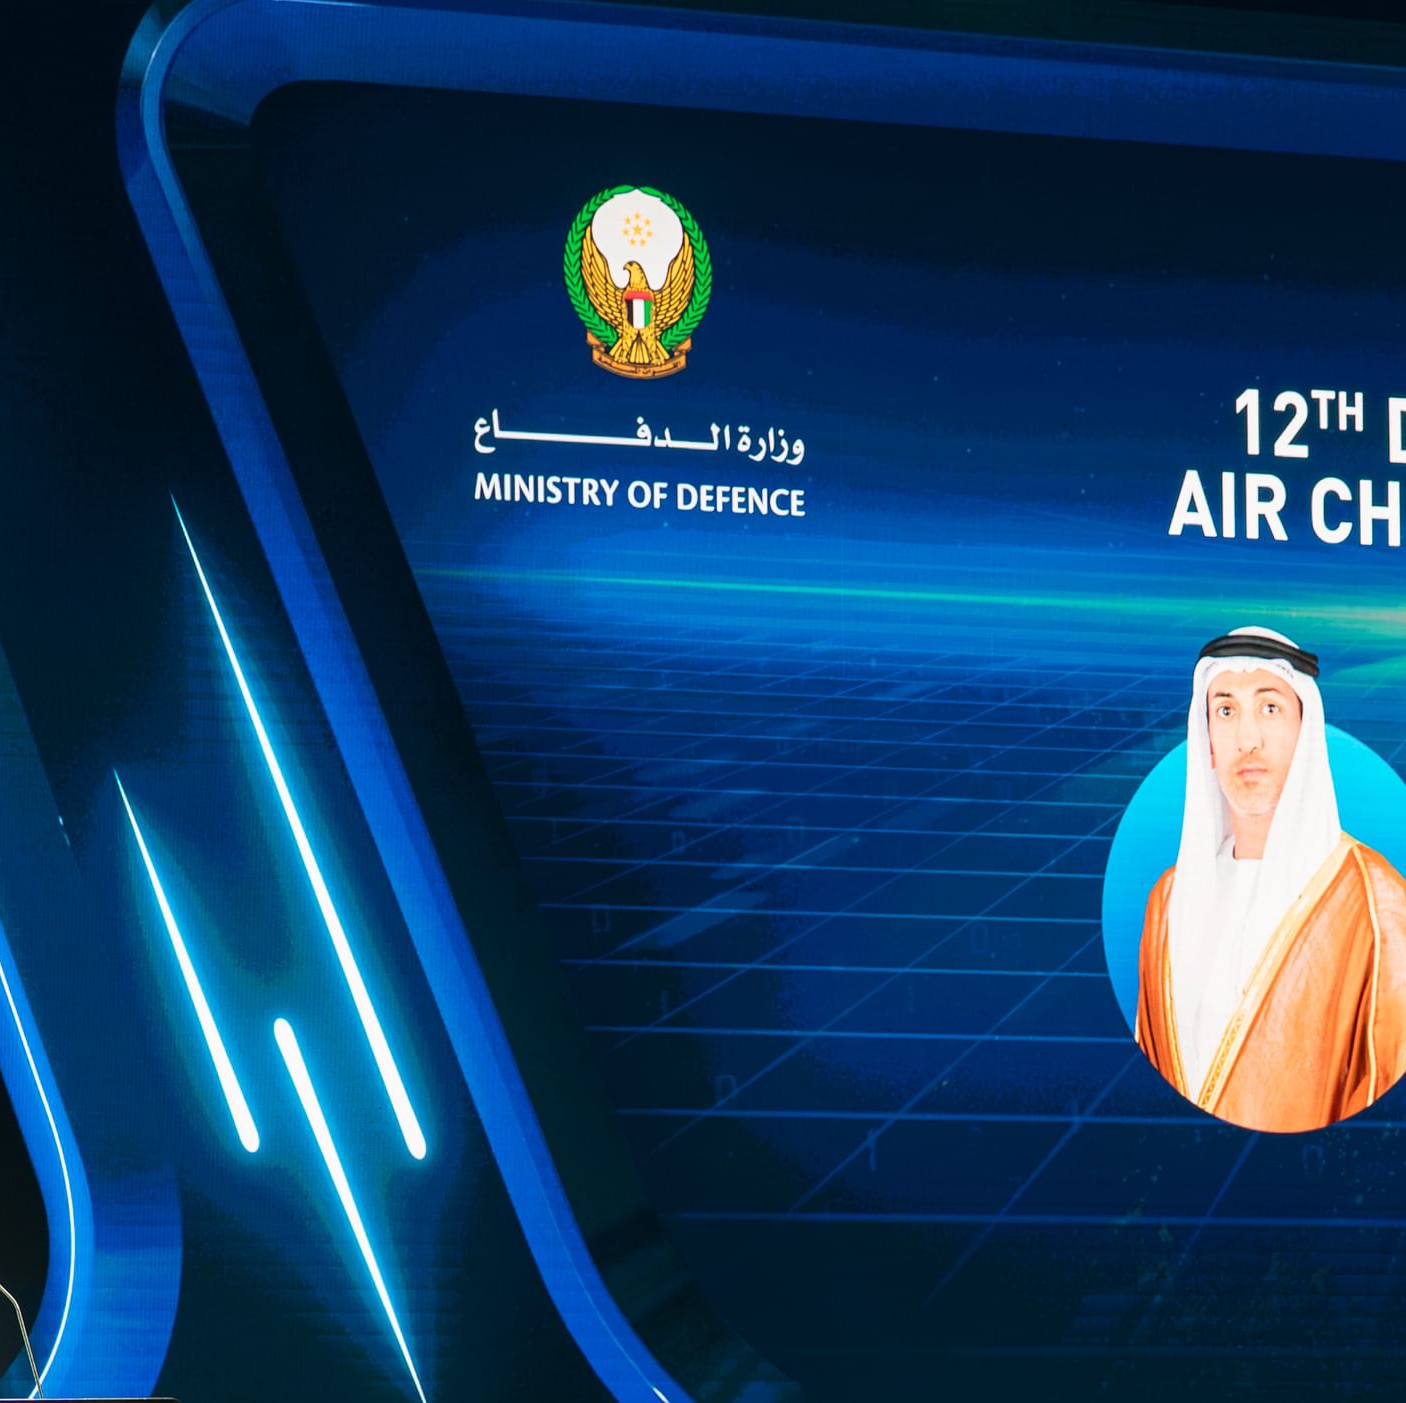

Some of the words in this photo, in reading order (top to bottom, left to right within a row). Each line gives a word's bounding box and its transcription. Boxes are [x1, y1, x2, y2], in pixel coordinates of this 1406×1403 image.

[737, 425, 806, 466] وزارة
[1234, 387, 1364, 458] 12TH
[474, 472, 620, 507] MINISTRY
[627, 480, 669, 510] OF
[677, 482, 806, 518] DEFENCE
[1168, 469, 1289, 541] AIR
